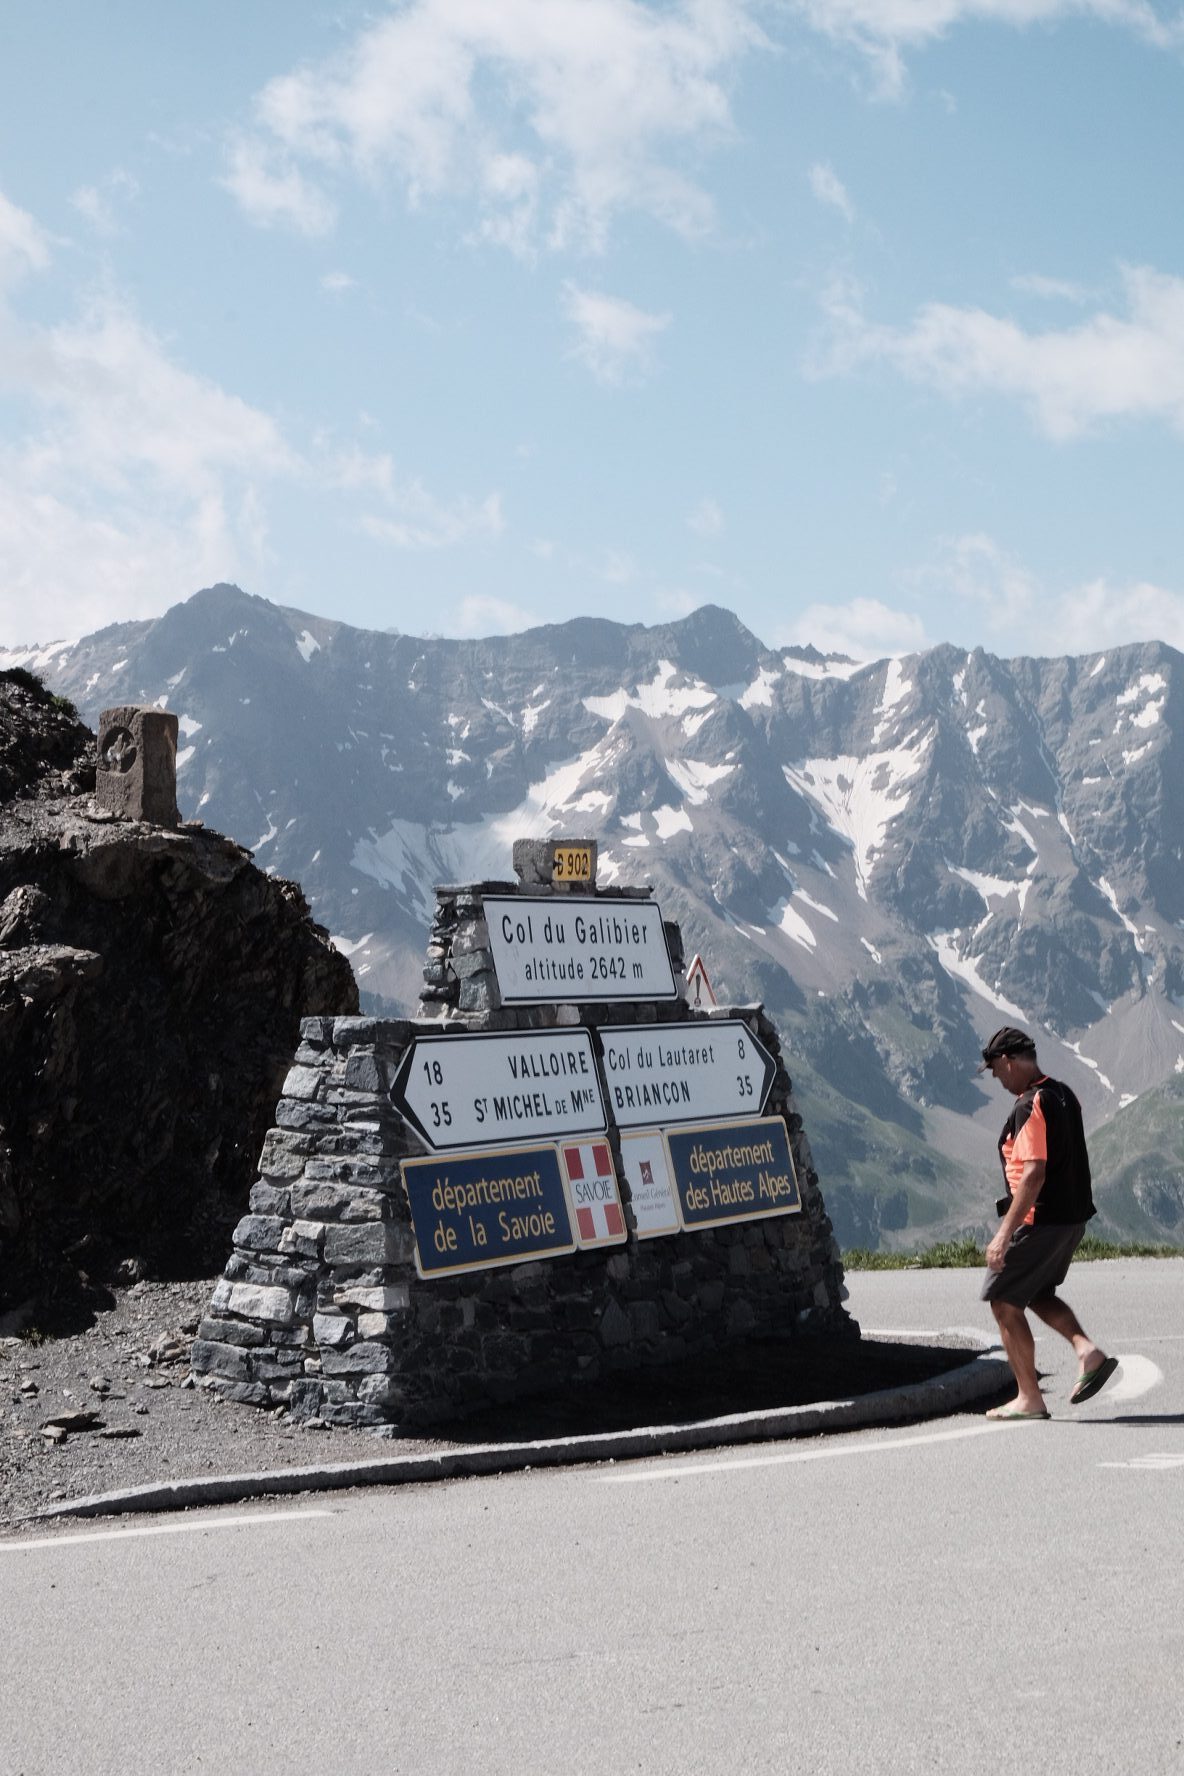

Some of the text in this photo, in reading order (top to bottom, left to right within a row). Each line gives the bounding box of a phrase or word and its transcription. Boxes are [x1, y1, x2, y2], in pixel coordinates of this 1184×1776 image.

[567, 853, 588, 876] 902
[502, 915, 647, 944] Col du Galibier
[525, 957, 643, 980] altitude 2642 m
[424, 1051, 589, 1085] 18 VALLOIRE
[608, 1039, 746, 1070] Col du Lautaret 8
[614, 1075, 753, 1109] BRIANÇON 35
[431, 1102, 452, 1127] 35
[493, 1093, 552, 1121] MICHEL
[555, 1099, 568, 1115] DE
[689, 1140, 775, 1177] département
[431, 1171, 543, 1216] département
[575, 1180, 613, 1203] SAVOIE
[686, 1170, 791, 1210] des Hautes Alpes
[433, 1205, 556, 1252] de la Savoie
